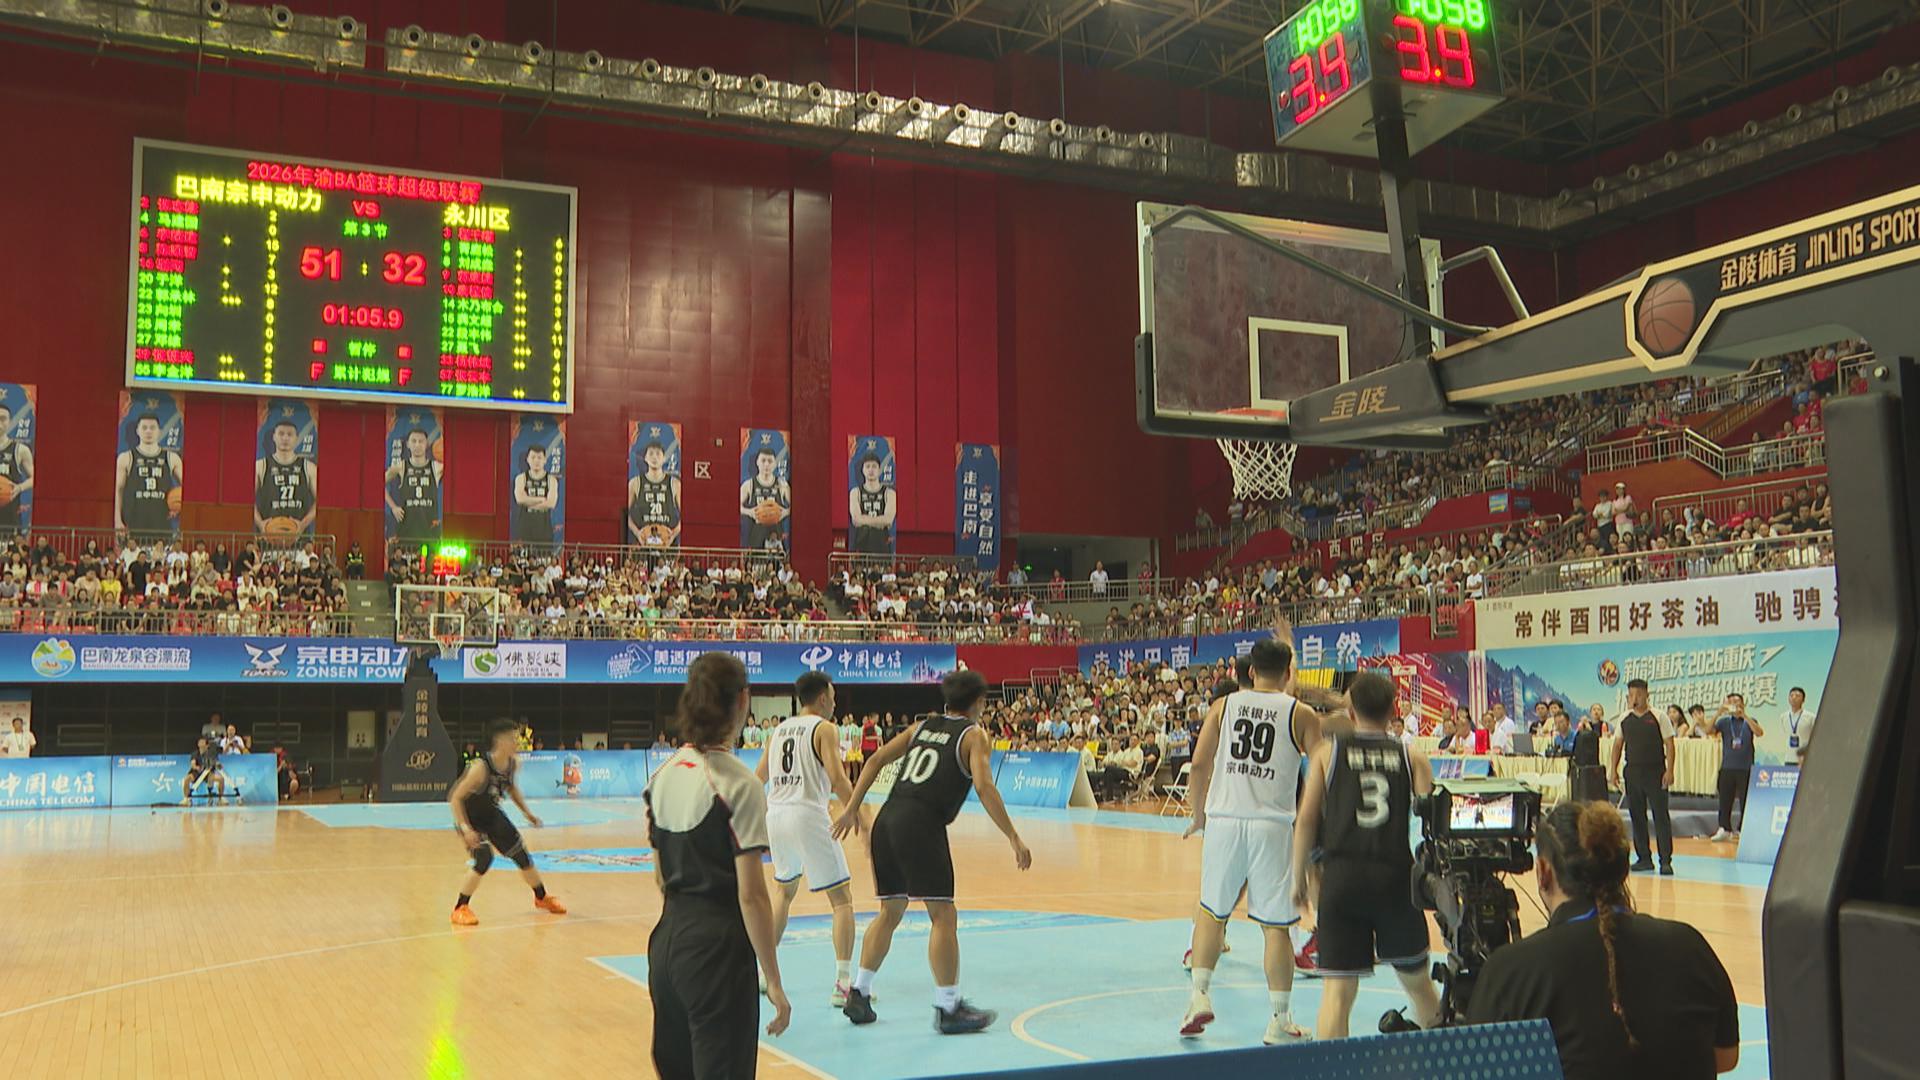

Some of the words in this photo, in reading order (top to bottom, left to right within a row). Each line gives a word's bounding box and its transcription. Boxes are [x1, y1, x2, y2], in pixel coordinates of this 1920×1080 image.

[1393, 14, 1475, 88] 3.9
[1289, 32, 1350, 124] 3.9
[176, 175, 322, 212] 巴南宗申动力
[247, 161, 482, 203] 2026年渝BA篮球超级联赛
[352, 200, 380, 217] VS
[444, 202, 511, 231] 永川区
[301, 247, 342, 280] 51
[383, 253, 427, 285] 32
[1720, 242, 1798, 292] 金陵体育
[1805, 221, 1865, 269] JINLING
[322, 303, 404, 328] 01:05.9
[1319, 386, 1400, 422] 金陵
[694, 460, 712, 480] 区
[280, 487, 294, 500] 27
[963, 470, 978, 534] 走进巴南
[978, 492, 993, 556] 享受自然
[1513, 595, 1720, 639] 常伴酉阳好茶油
[1754, 586, 1839, 624] 驰骋
[83, 647, 189, 663] 巴南龙泉谷漂流
[296, 666, 358, 678] ZONSEN
[505, 650, 561, 667] 佛影峡
[839, 648, 902, 670] 中国电信
[1238, 705, 1278, 723] 张银兴
[782, 738, 795, 774] 8
[1231, 719, 1275, 764] 39
[901, 745, 939, 784] 10
[1226, 762, 1275, 780] 宗申动力
[0, 770, 95, 799] 中国电信
[41, 796, 95, 806] TELECOM
[1356, 772, 1390, 828] 3
